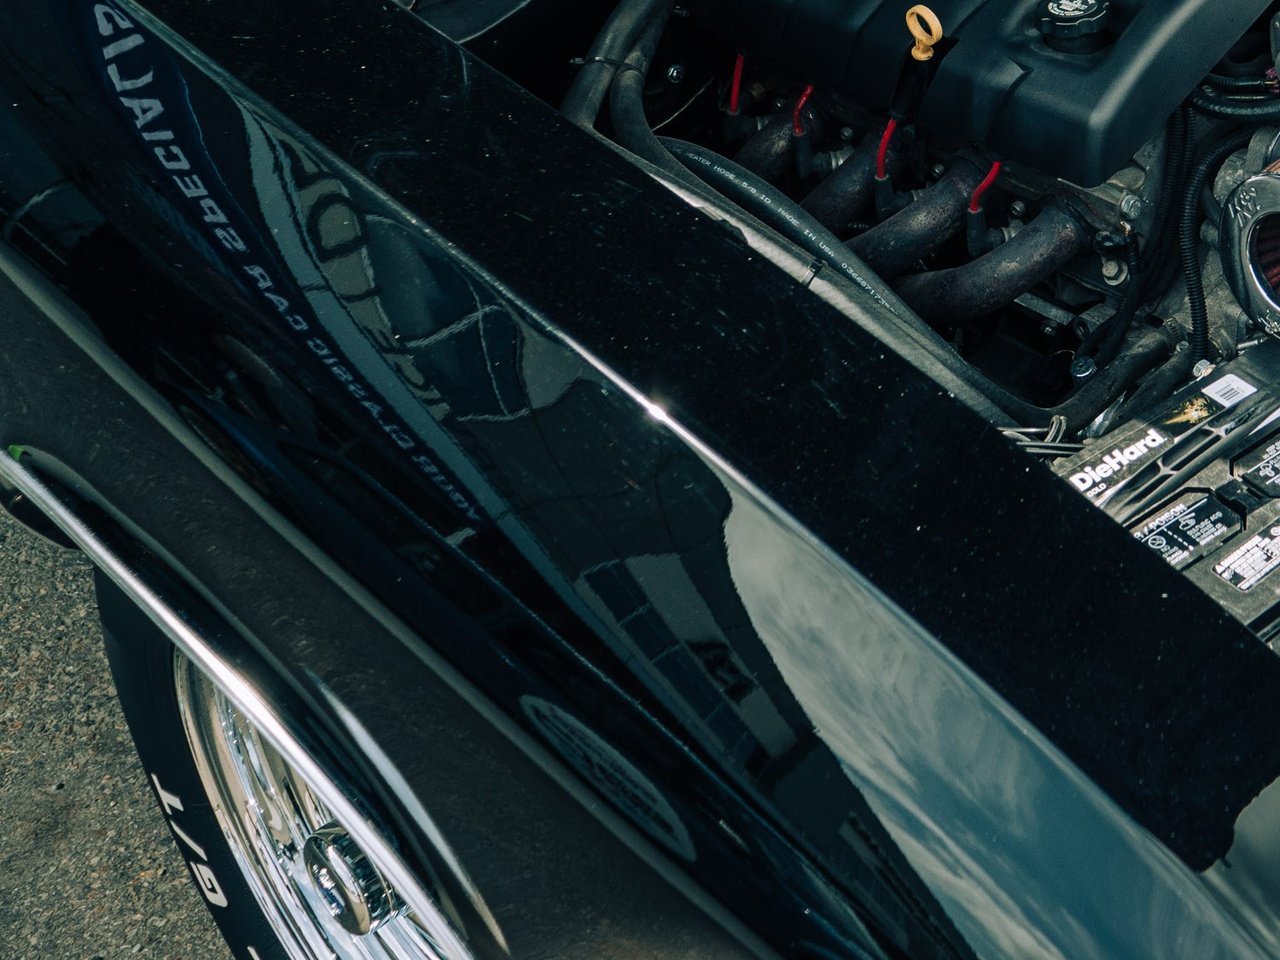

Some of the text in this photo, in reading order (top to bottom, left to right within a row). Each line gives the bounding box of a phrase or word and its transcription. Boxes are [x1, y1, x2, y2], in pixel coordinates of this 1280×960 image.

[714, 165, 736, 180] HOSE
[760, 194, 771, 204] ID
[778, 208, 799, 227] MADE
[804, 229, 816, 241] IN
[819, 242, 834, 258] USA
[1069, 428, 1168, 491] DieHard
[1148, 504, 1187, 530] POISON
